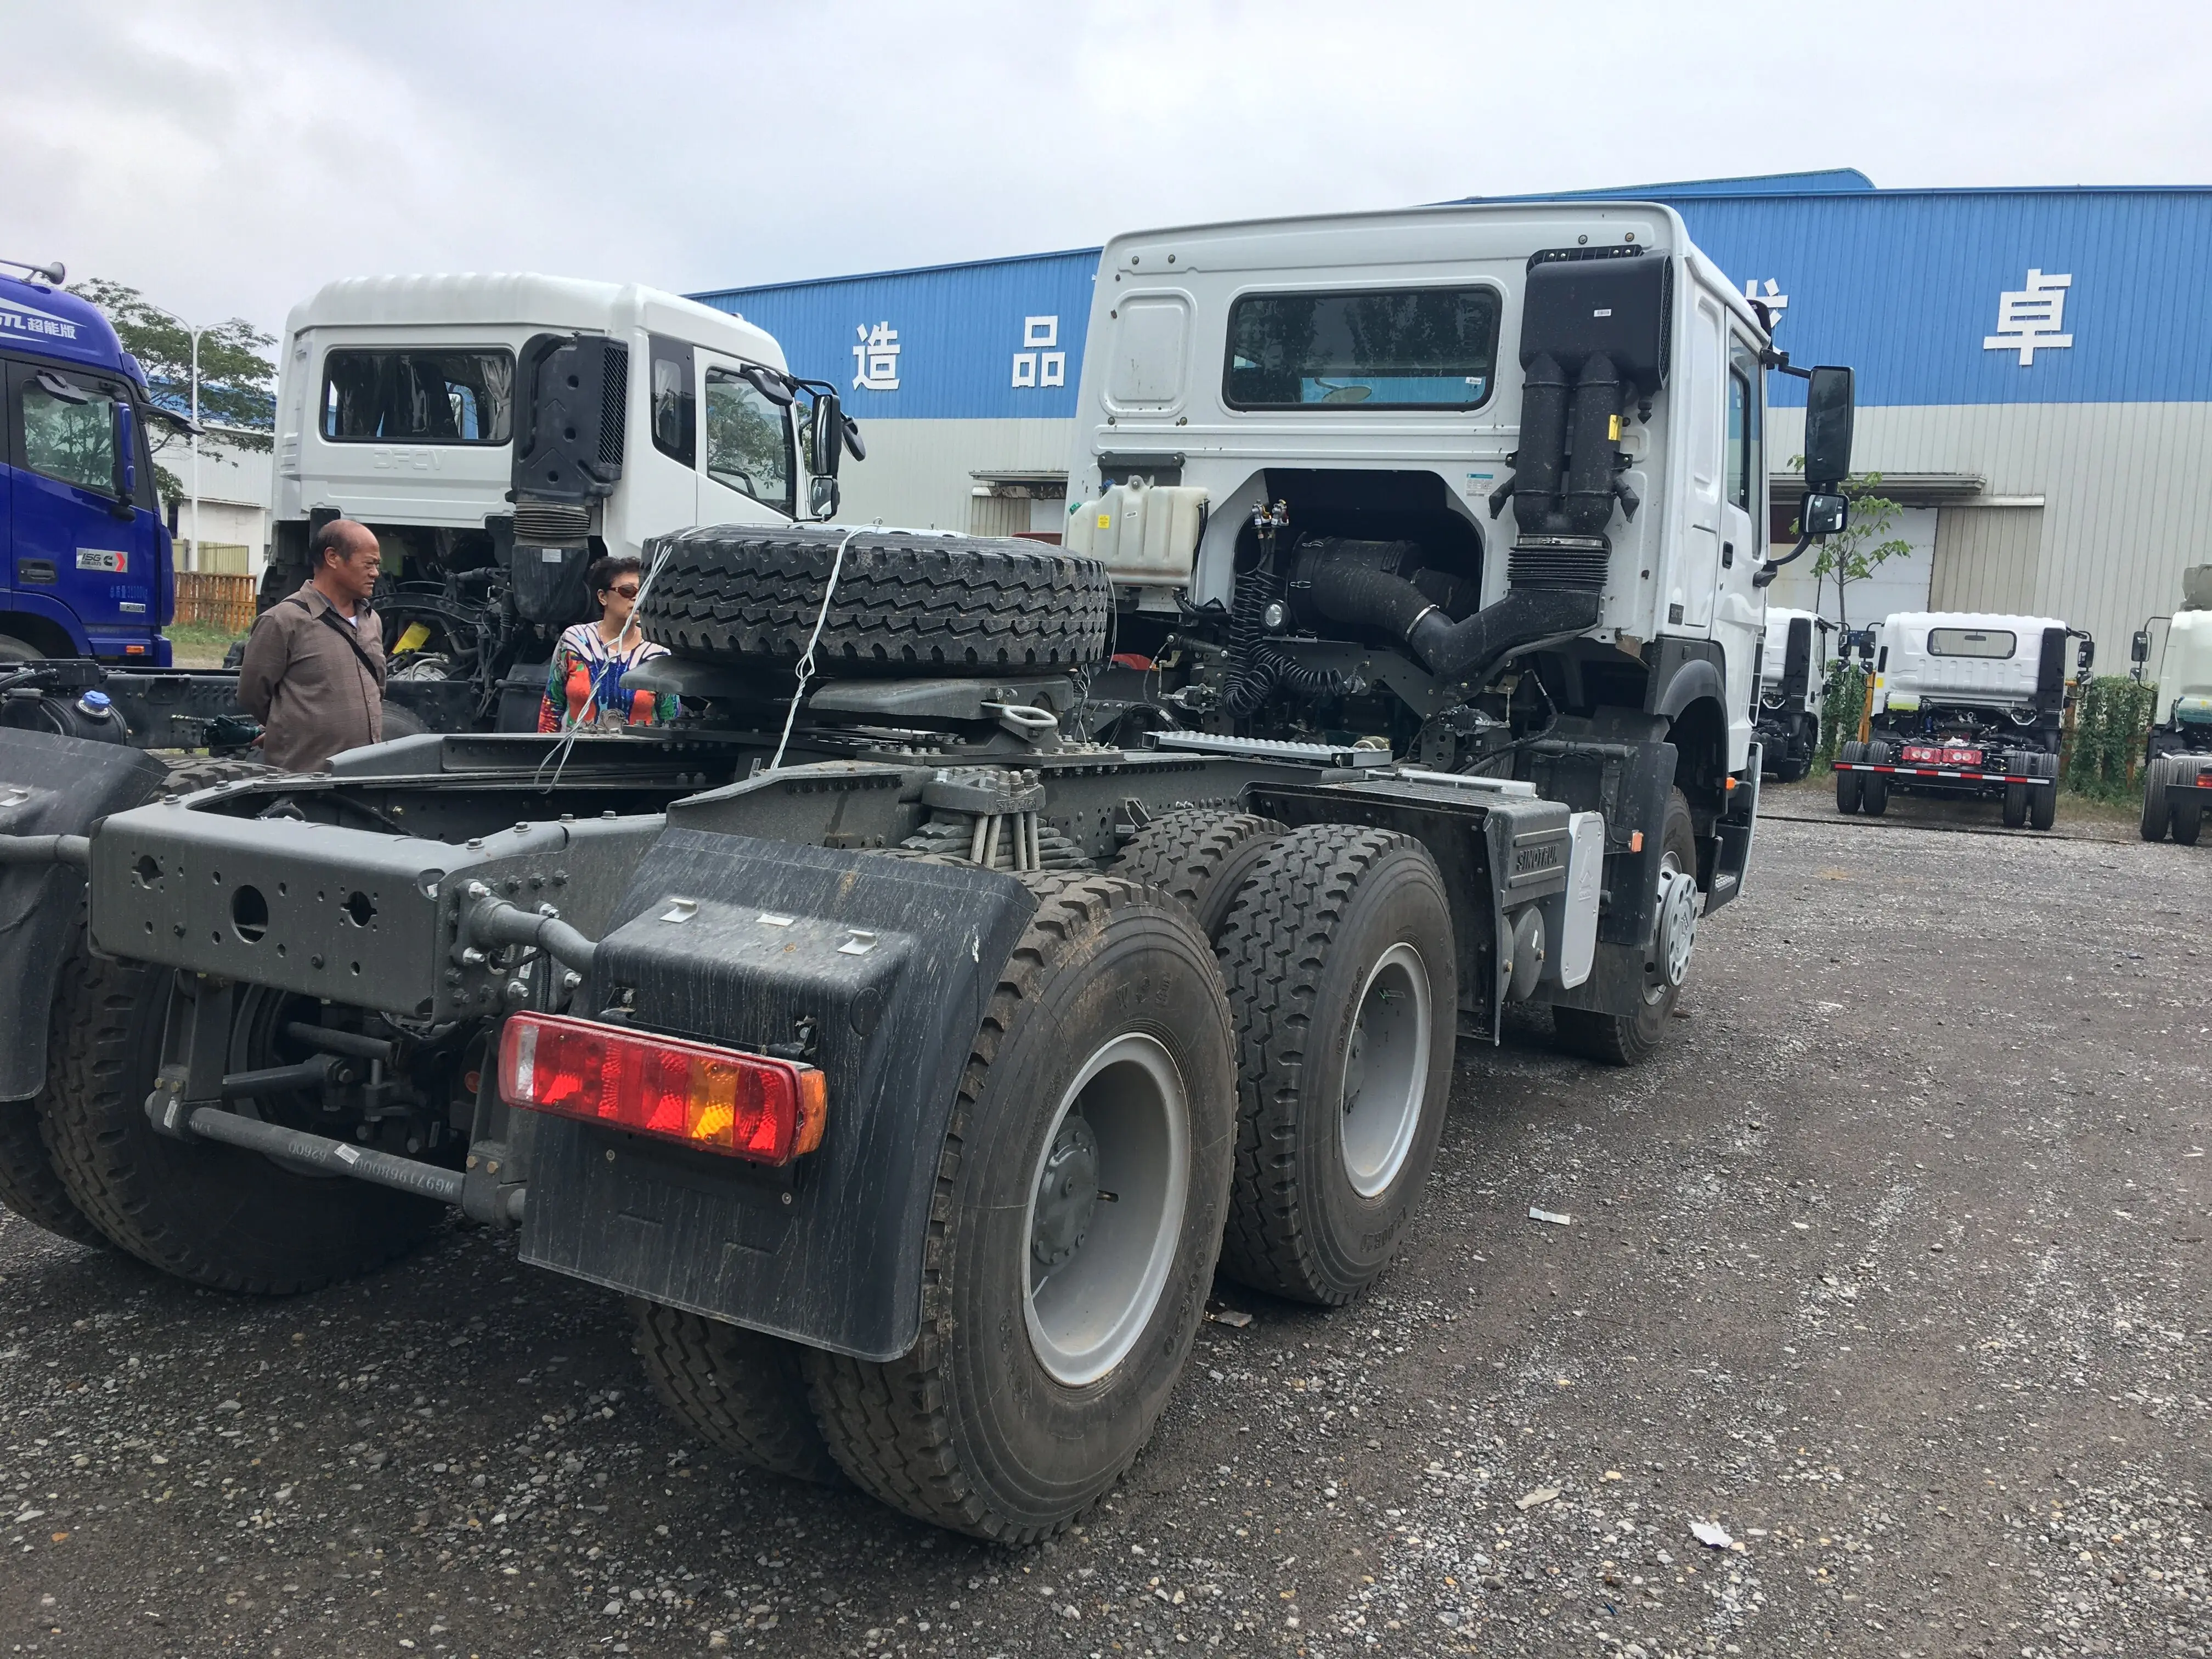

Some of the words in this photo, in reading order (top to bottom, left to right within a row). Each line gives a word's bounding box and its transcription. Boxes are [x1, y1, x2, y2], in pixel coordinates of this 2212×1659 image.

[27, 318, 77, 340] 超能版
[852, 321, 900, 391] 造
[1012, 315, 1065, 388] 品
[1983, 268, 2073, 366] 卓
[374, 448, 448, 471] DFCV
[82, 553, 101, 562] ISG
[288, 1141, 328, 1162] 62600
